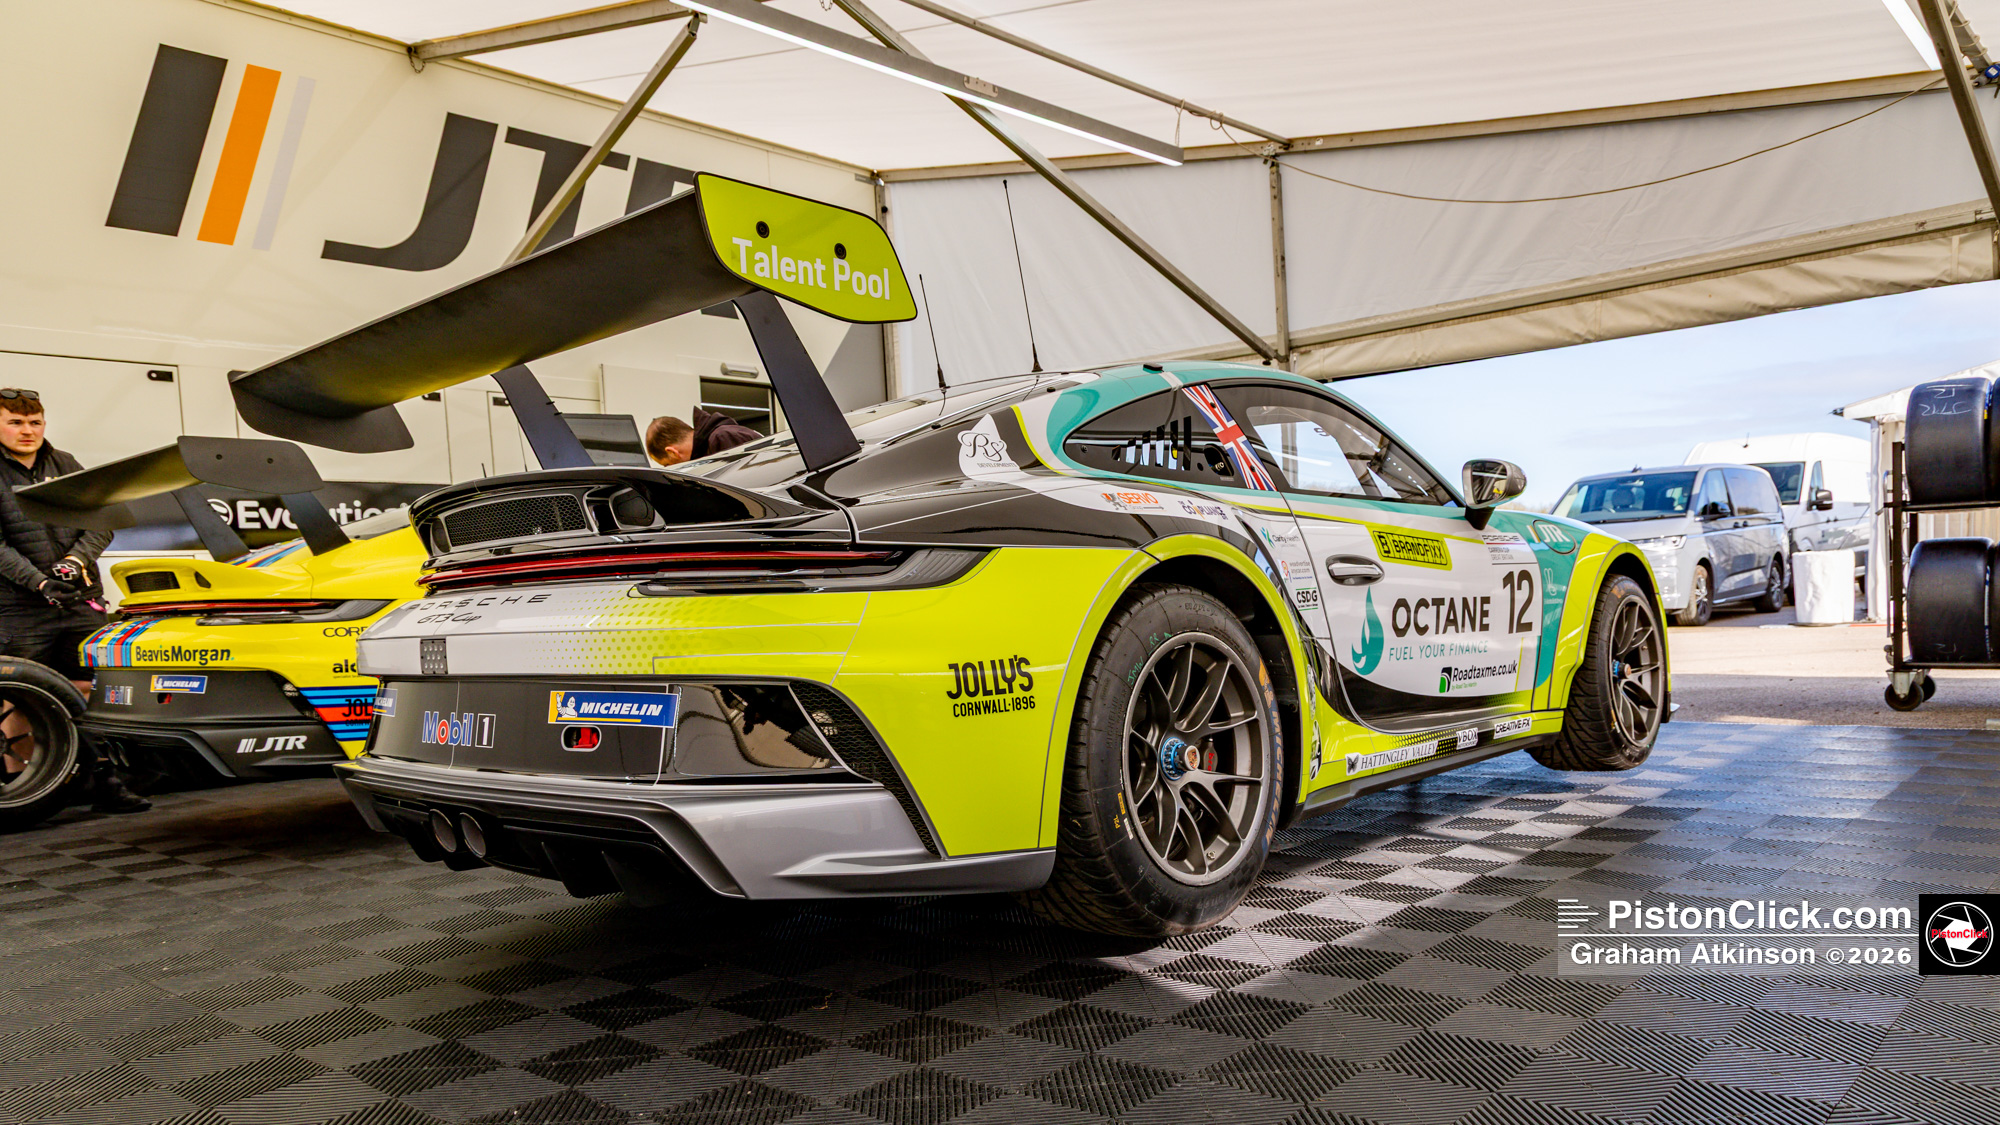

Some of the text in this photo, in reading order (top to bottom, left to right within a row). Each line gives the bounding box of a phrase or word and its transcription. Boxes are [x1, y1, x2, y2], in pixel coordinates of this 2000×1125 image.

[732, 237, 890, 300] Talent Pool
[1116, 492, 1159, 504] SERVO
[405, 594, 552, 611] PORSCHE
[1296, 590, 1318, 603] CSDG
[1502, 569, 1534, 634] 12
[1392, 596, 1491, 638] OCTANE
[1389, 640, 1488, 661] FUEL YOUR FINANCE
[946, 654, 1034, 699] JOLLY'S
[1452, 660, 1518, 682] Roadtaxme.co.uk
[579, 702, 663, 716] MICHELIN
[422, 711, 474, 747] Mobil
[1496, 719, 1521, 733] CREATIVE
[1521, 717, 1530, 728] FX
[254, 735, 308, 752] JTR
[1458, 729, 1478, 743] VBOX
[1361, 742, 1438, 769] HATTINGLEY VALLEY
[1266, 710, 1283, 846] MICHELIN
